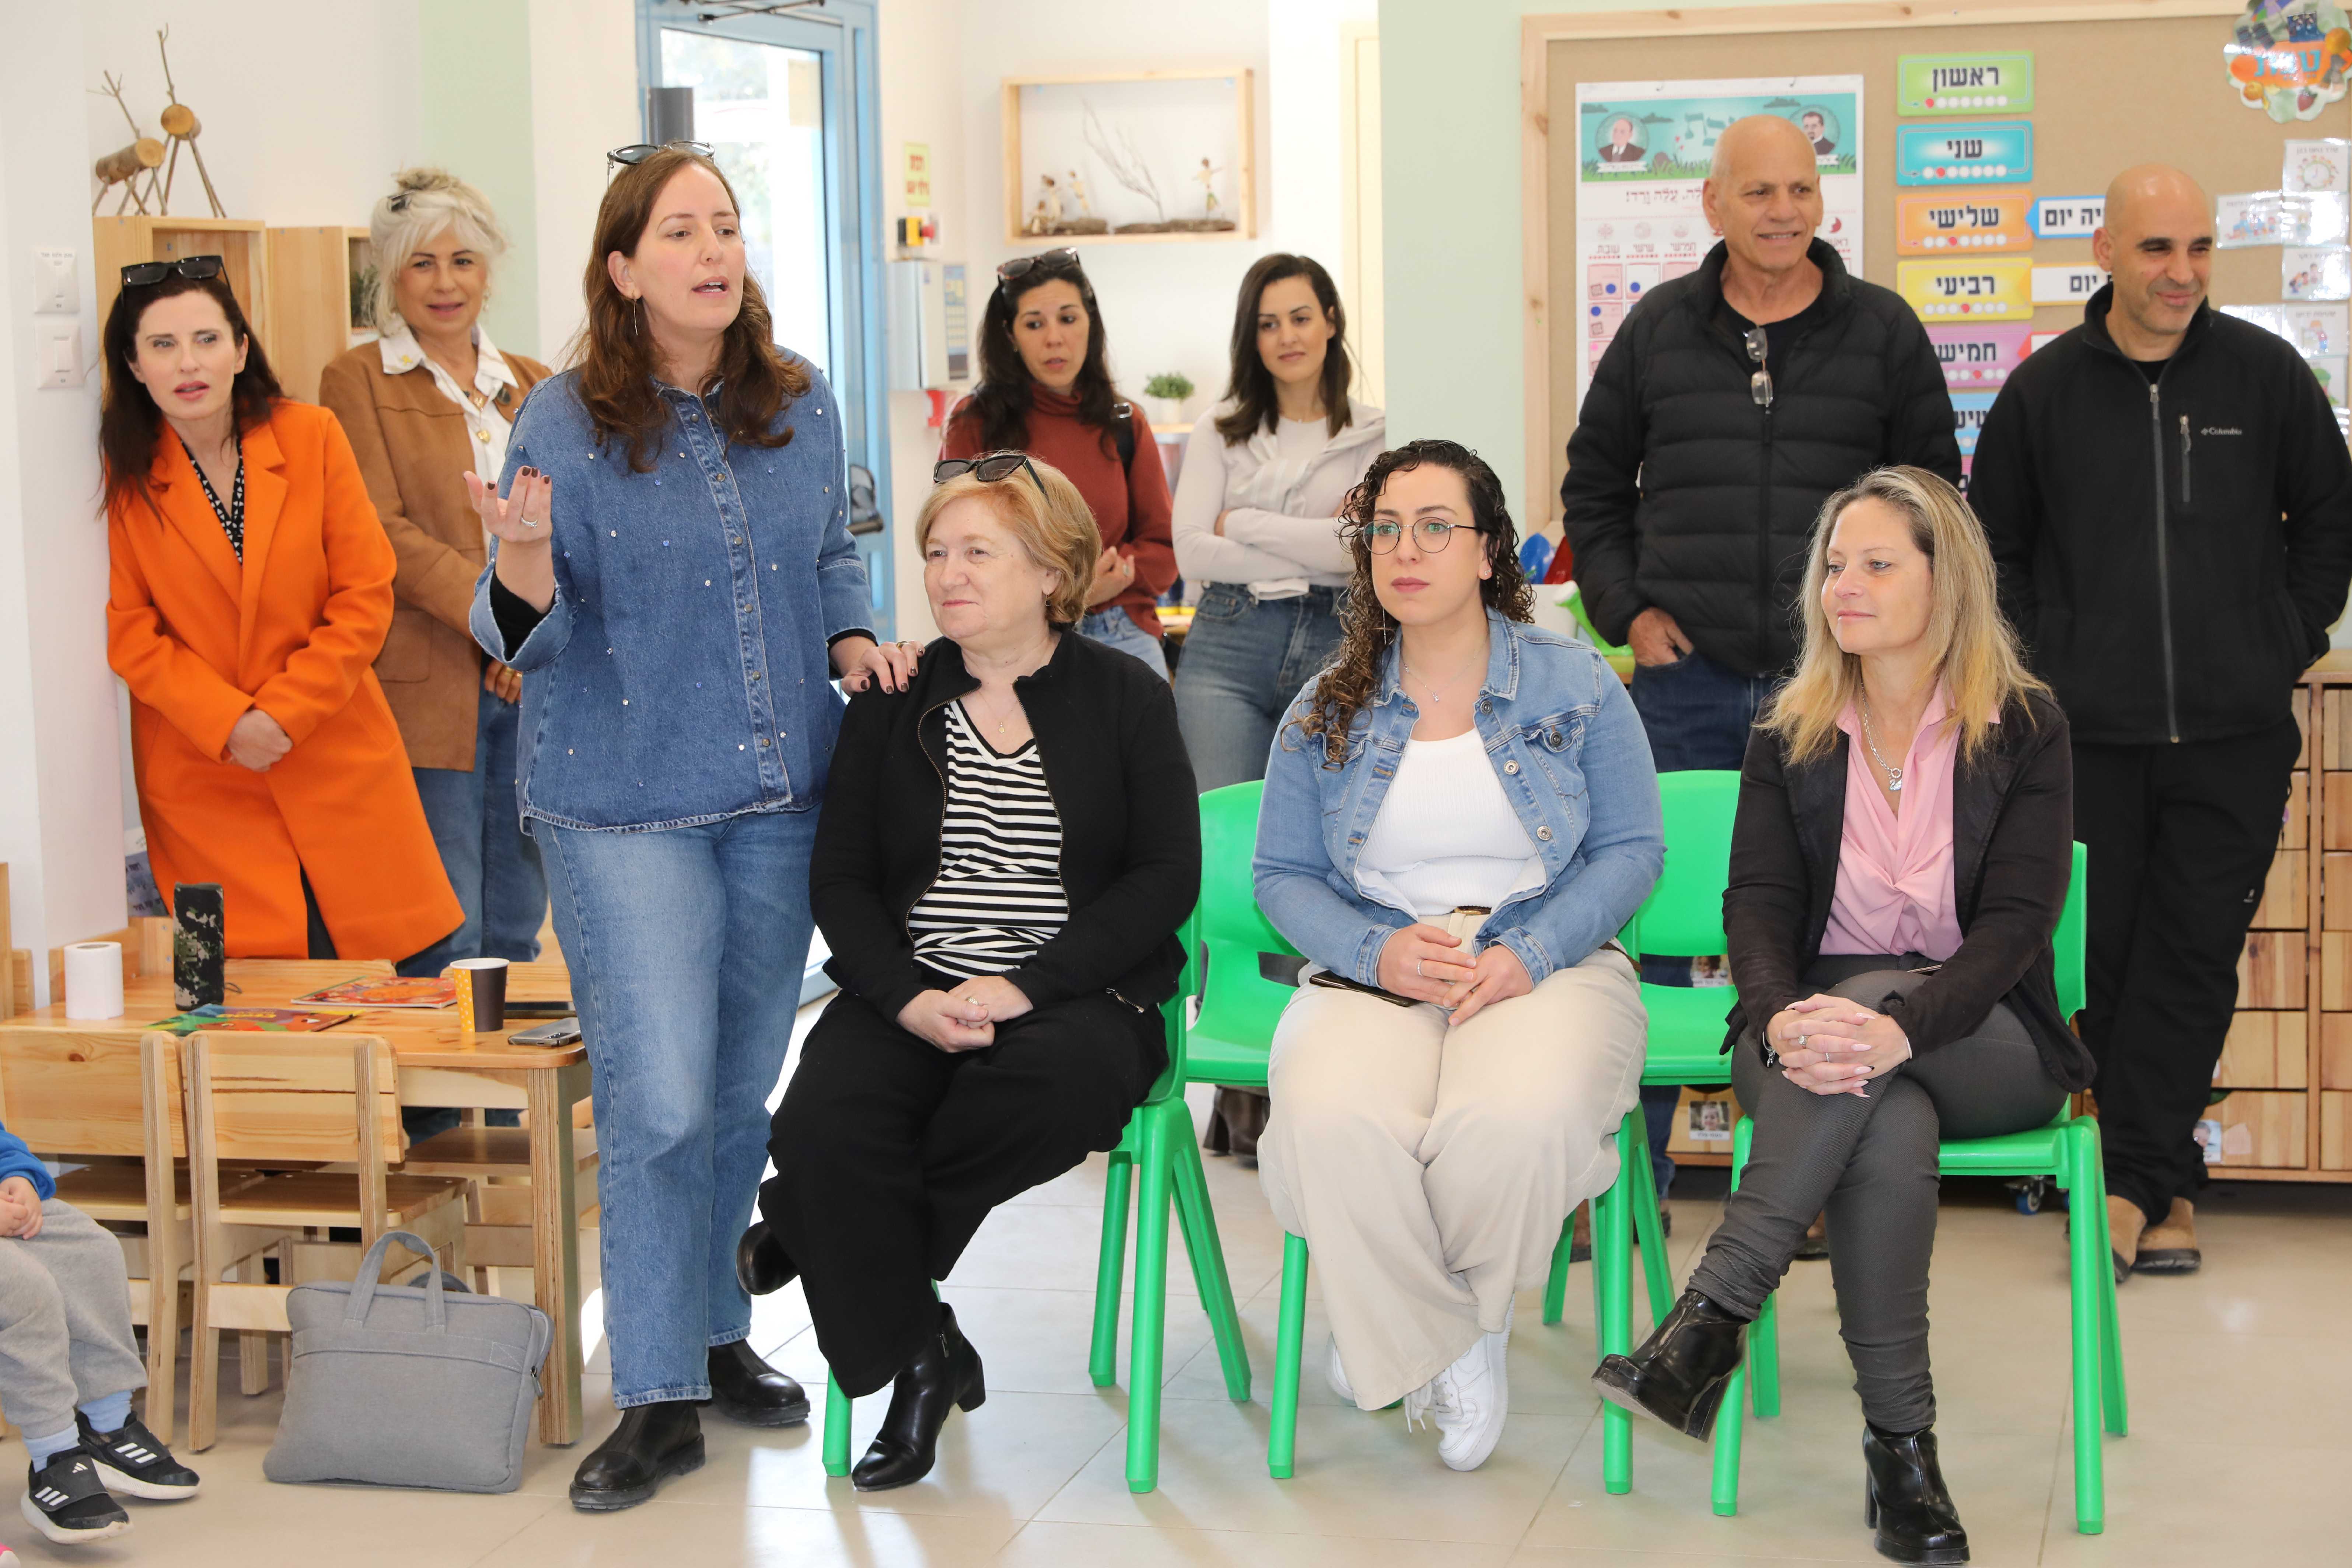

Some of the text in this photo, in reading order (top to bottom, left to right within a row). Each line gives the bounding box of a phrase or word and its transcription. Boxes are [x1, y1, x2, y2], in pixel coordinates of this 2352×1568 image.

[1933, 67, 1999, 93] ראשון
[1947, 139, 1982, 158] שני
[1929, 205, 1999, 228] שלישי
[2045, 209, 2073, 226] יום
[1936, 276, 1995, 295] רביעי
[2070, 275, 2097, 292] יום
[1938, 343, 1996, 362] חמיש
[2208, 426, 2243, 435] Columbia
